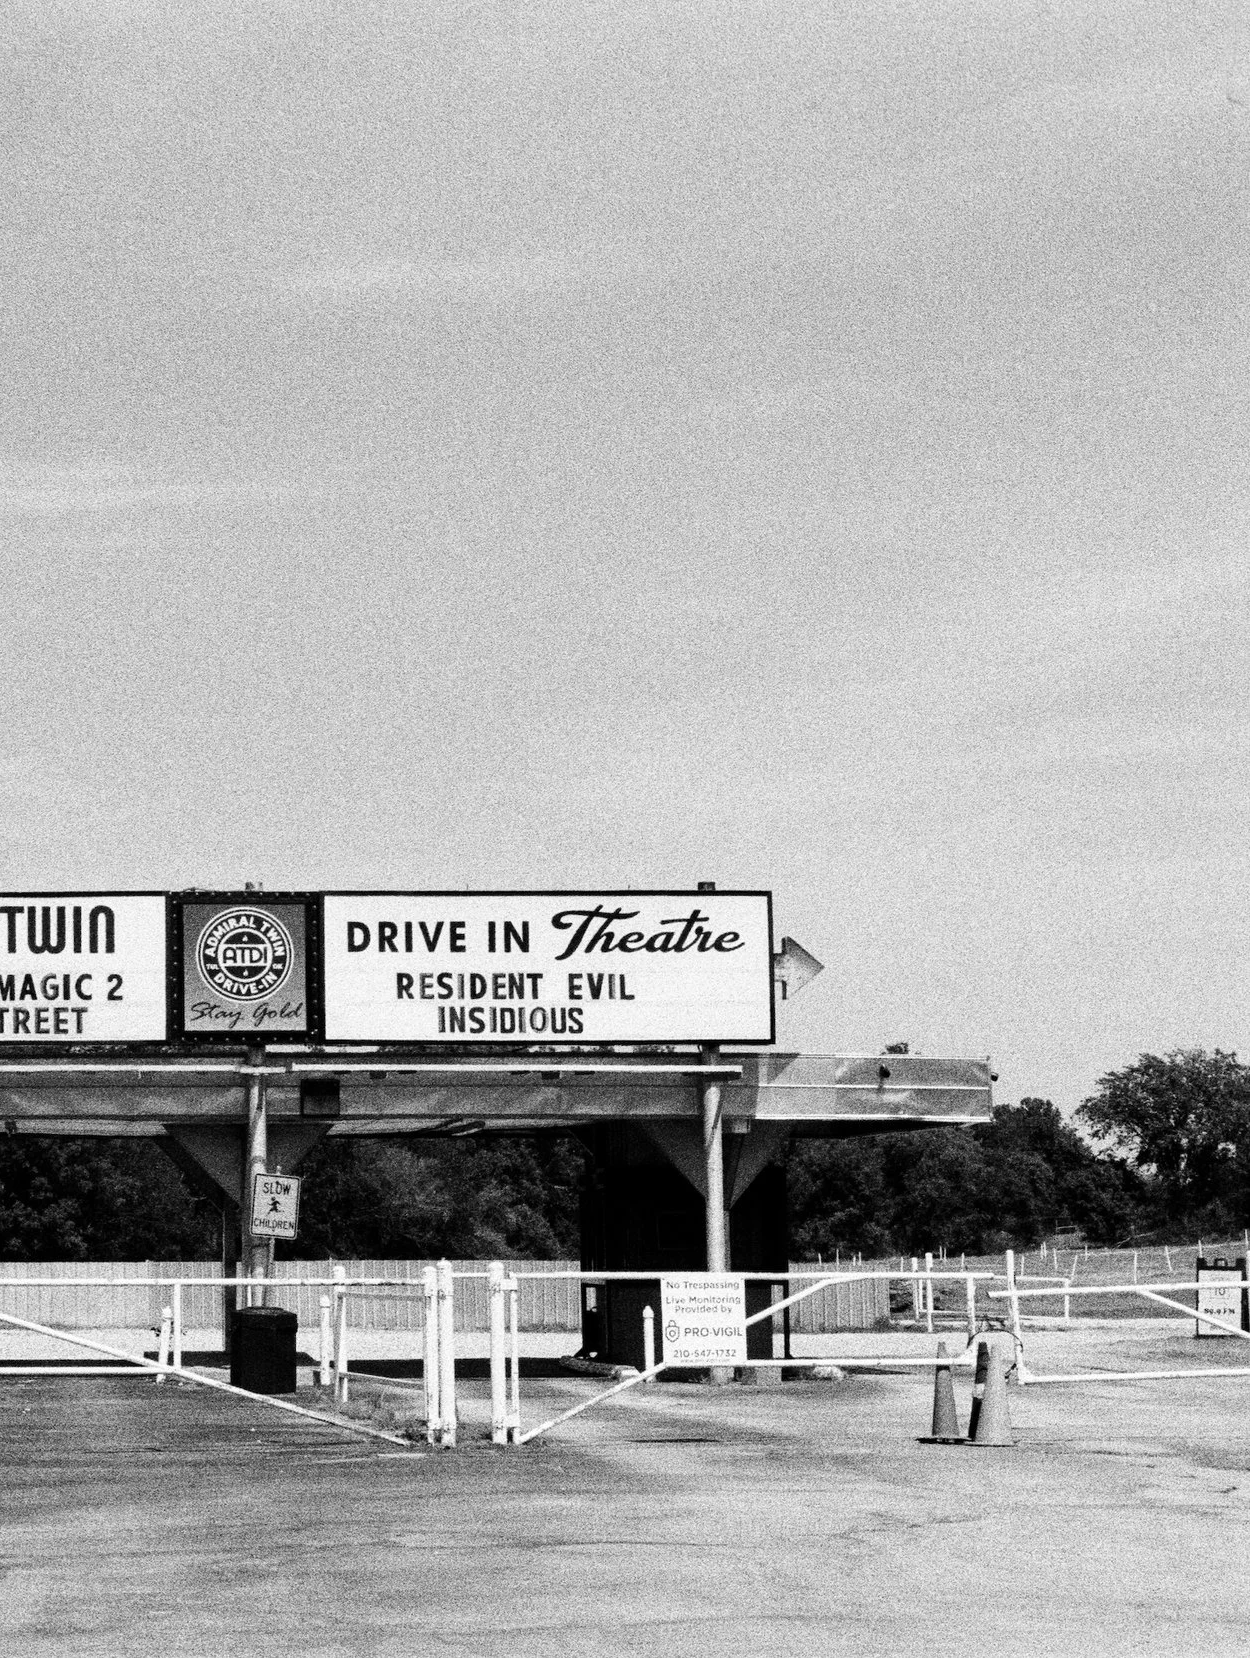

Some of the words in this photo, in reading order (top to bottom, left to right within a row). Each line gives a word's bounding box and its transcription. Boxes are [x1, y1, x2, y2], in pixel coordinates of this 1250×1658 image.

[204, 915, 257, 958] ADMIRAL
[260, 920, 286, 957] TWIN
[347, 920, 467, 953] DRIVE
[488, 921, 531, 953] IN
[551, 904, 746, 960] Theatre
[222, 946, 268, 964] ATDI
[106, 974, 124, 1001] 2
[213, 971, 278, 995] DRIVE-IN
[396, 972, 544, 1000] RESIDENT
[568, 972, 636, 1001] EVIL
[190, 1001, 245, 1028] Stay
[252, 1001, 303, 1027] Gold
[437, 1006, 584, 1034] INSIDIOUS
[262, 1182, 291, 1195] SLOW
[254, 1218, 294, 1229] CHILDREN
[666, 1281, 680, 1289] No
[683, 1281, 739, 1290] Trespassing
[665, 1296, 685, 1304] Live
[689, 1296, 741, 1304] Monitoring
[675, 1305, 718, 1313] Provided
[721, 1305, 732, 1313] by
[684, 1327, 743, 1337] PRO-VIGIL
[673, 1349, 736, 1358] 210-547-1732
